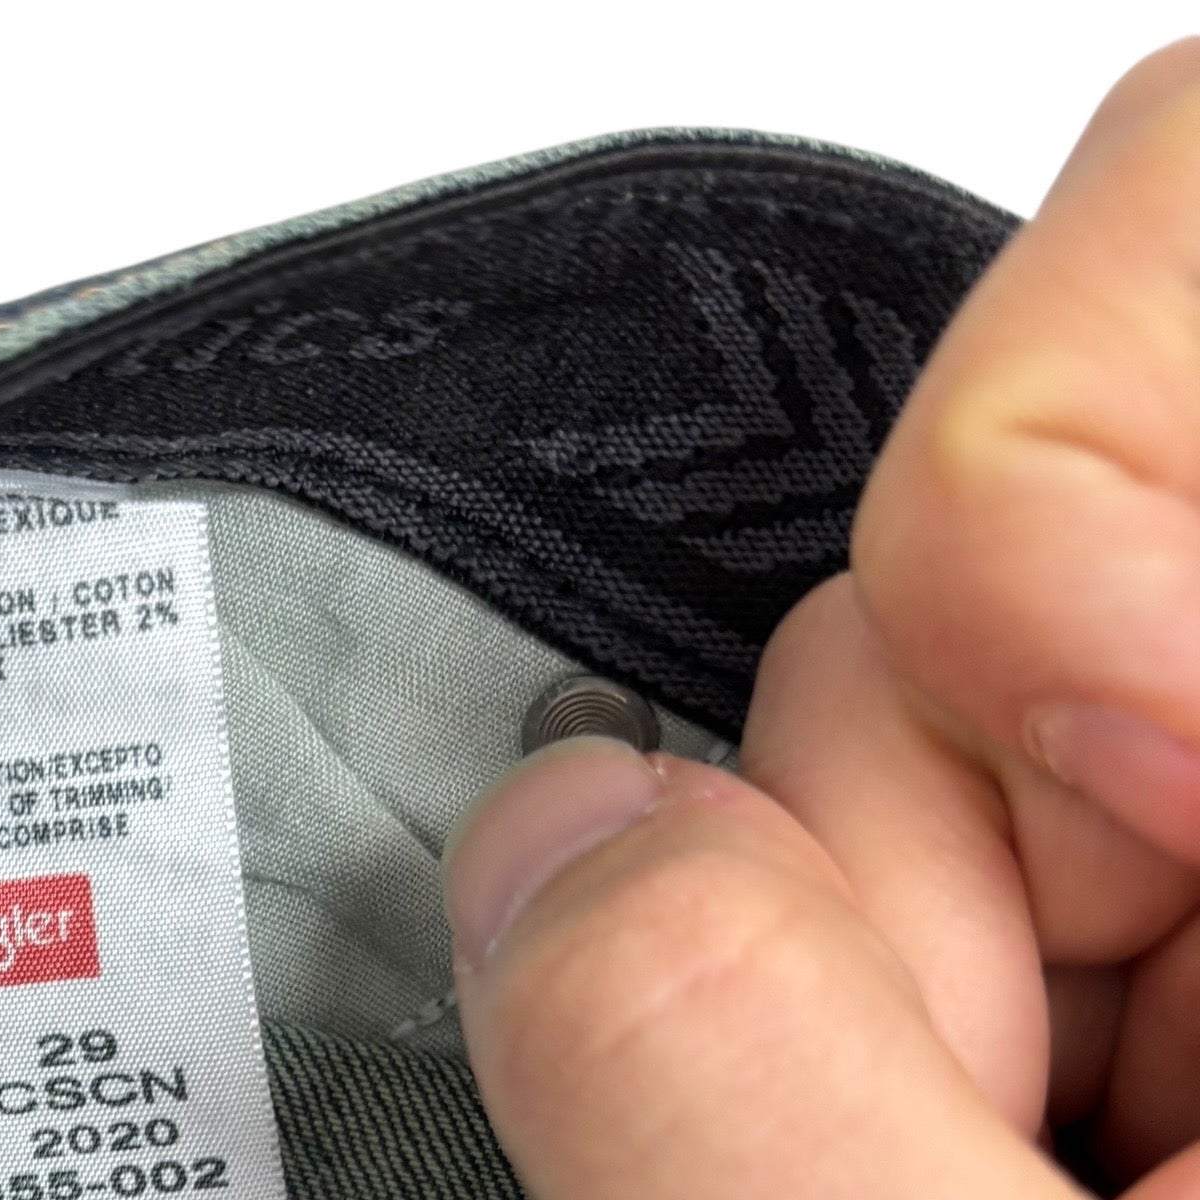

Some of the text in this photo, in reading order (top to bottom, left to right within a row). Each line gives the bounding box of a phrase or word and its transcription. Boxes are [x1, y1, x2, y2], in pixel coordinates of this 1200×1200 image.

[72, 567, 175, 608] COTON
[135, 600, 179, 633] 2%
[10, 790, 39, 817] OF
[37, 1028, 118, 1069] 29
[31, 1117, 179, 1160] 2020
